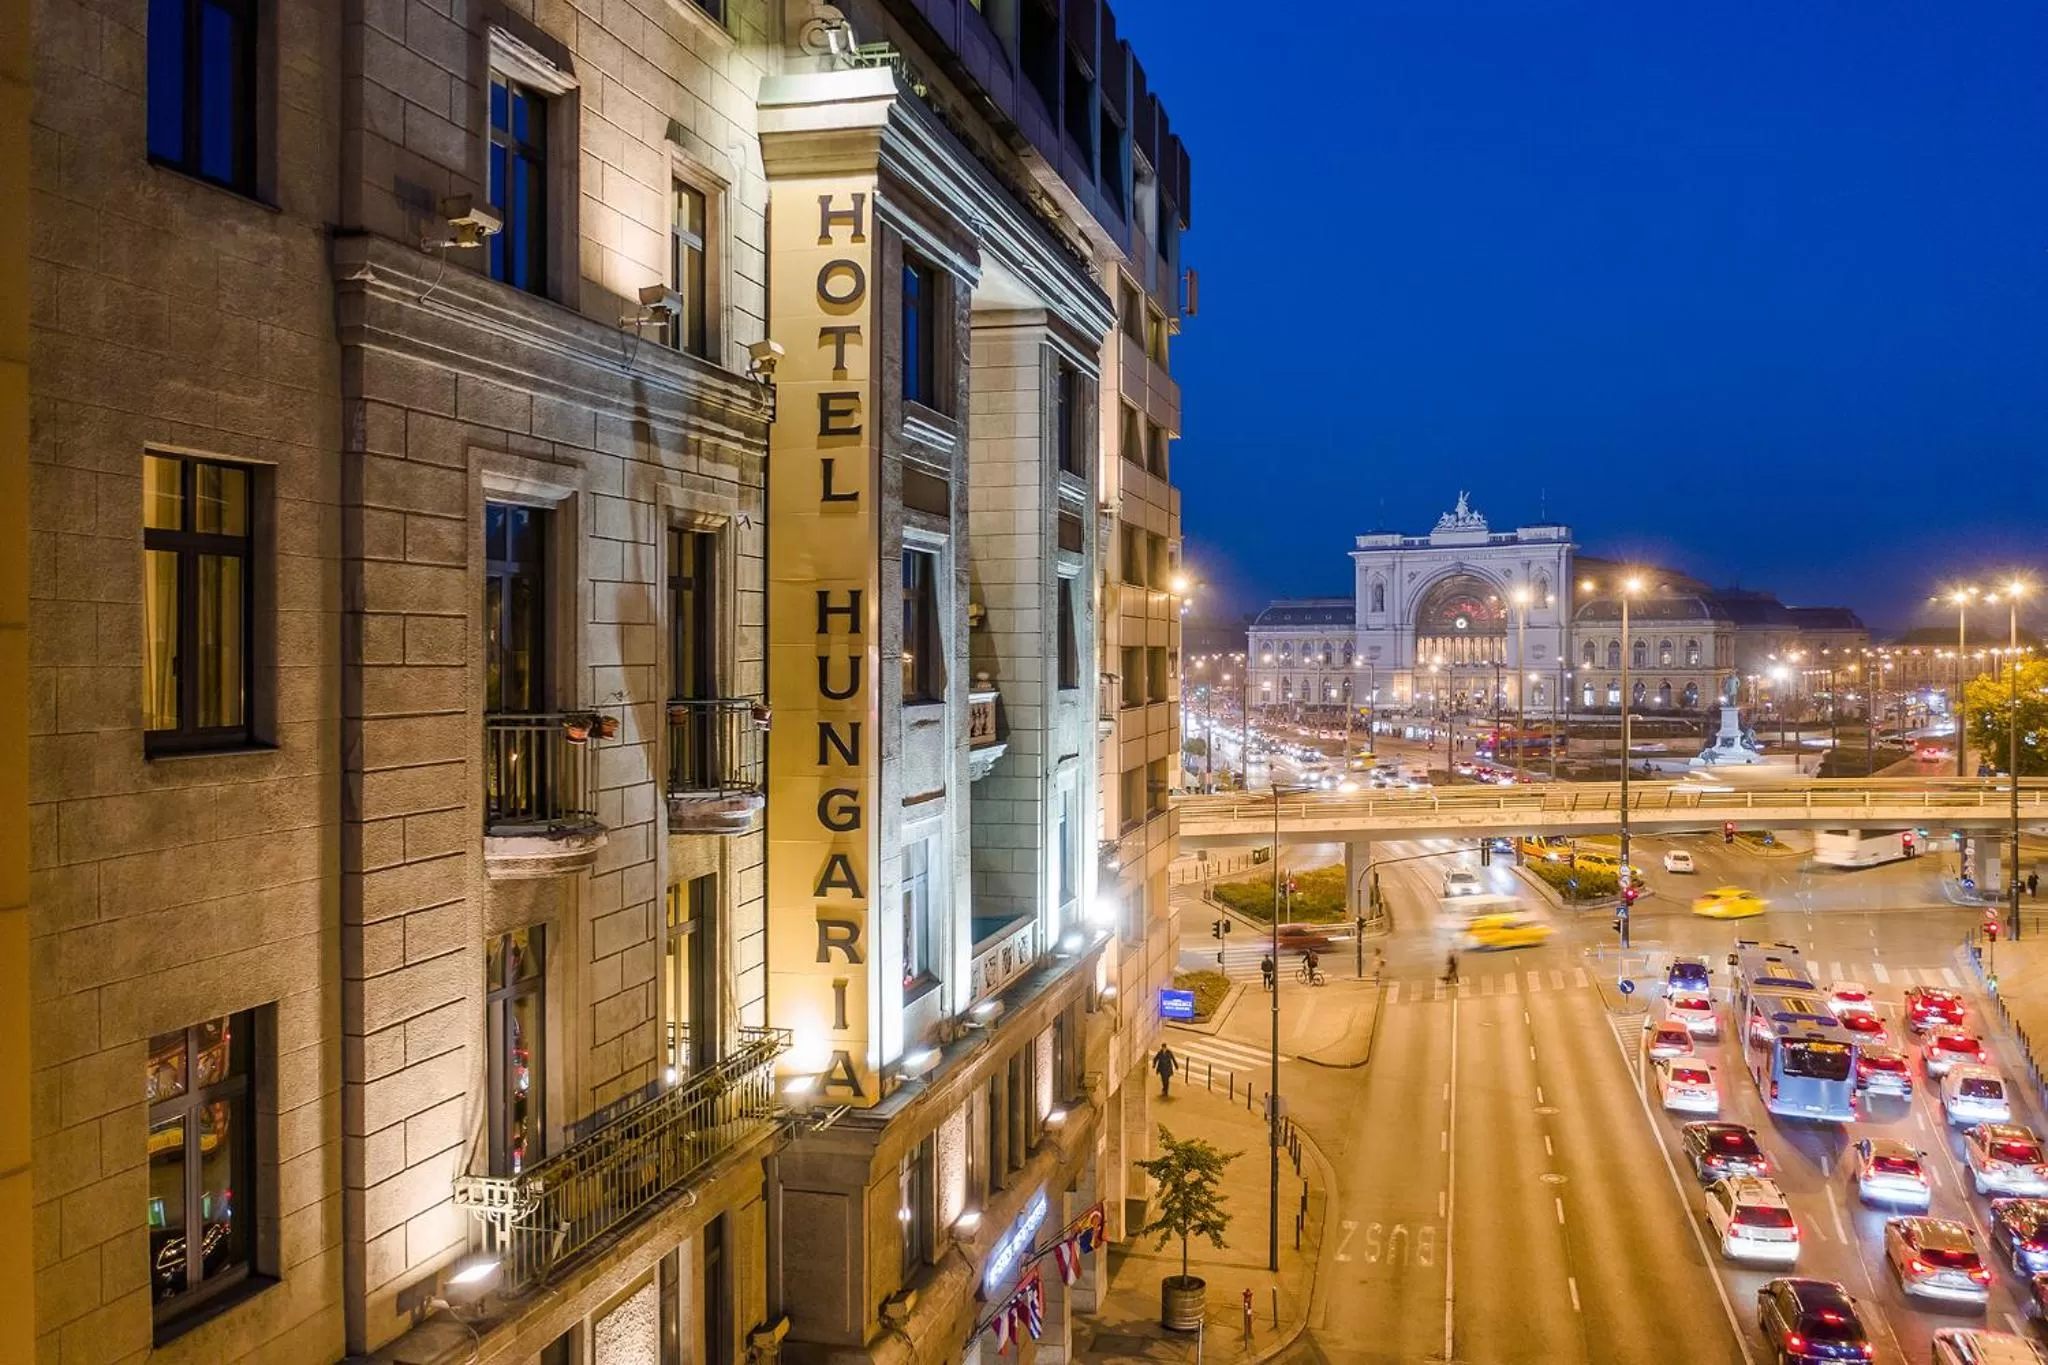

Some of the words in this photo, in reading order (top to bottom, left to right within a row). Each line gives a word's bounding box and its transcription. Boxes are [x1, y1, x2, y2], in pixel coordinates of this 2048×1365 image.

[816, 193, 866, 502] HOTEL
[813, 589, 865, 1098] HUNGARIA
[1334, 1220, 1437, 1267] BUSZ
